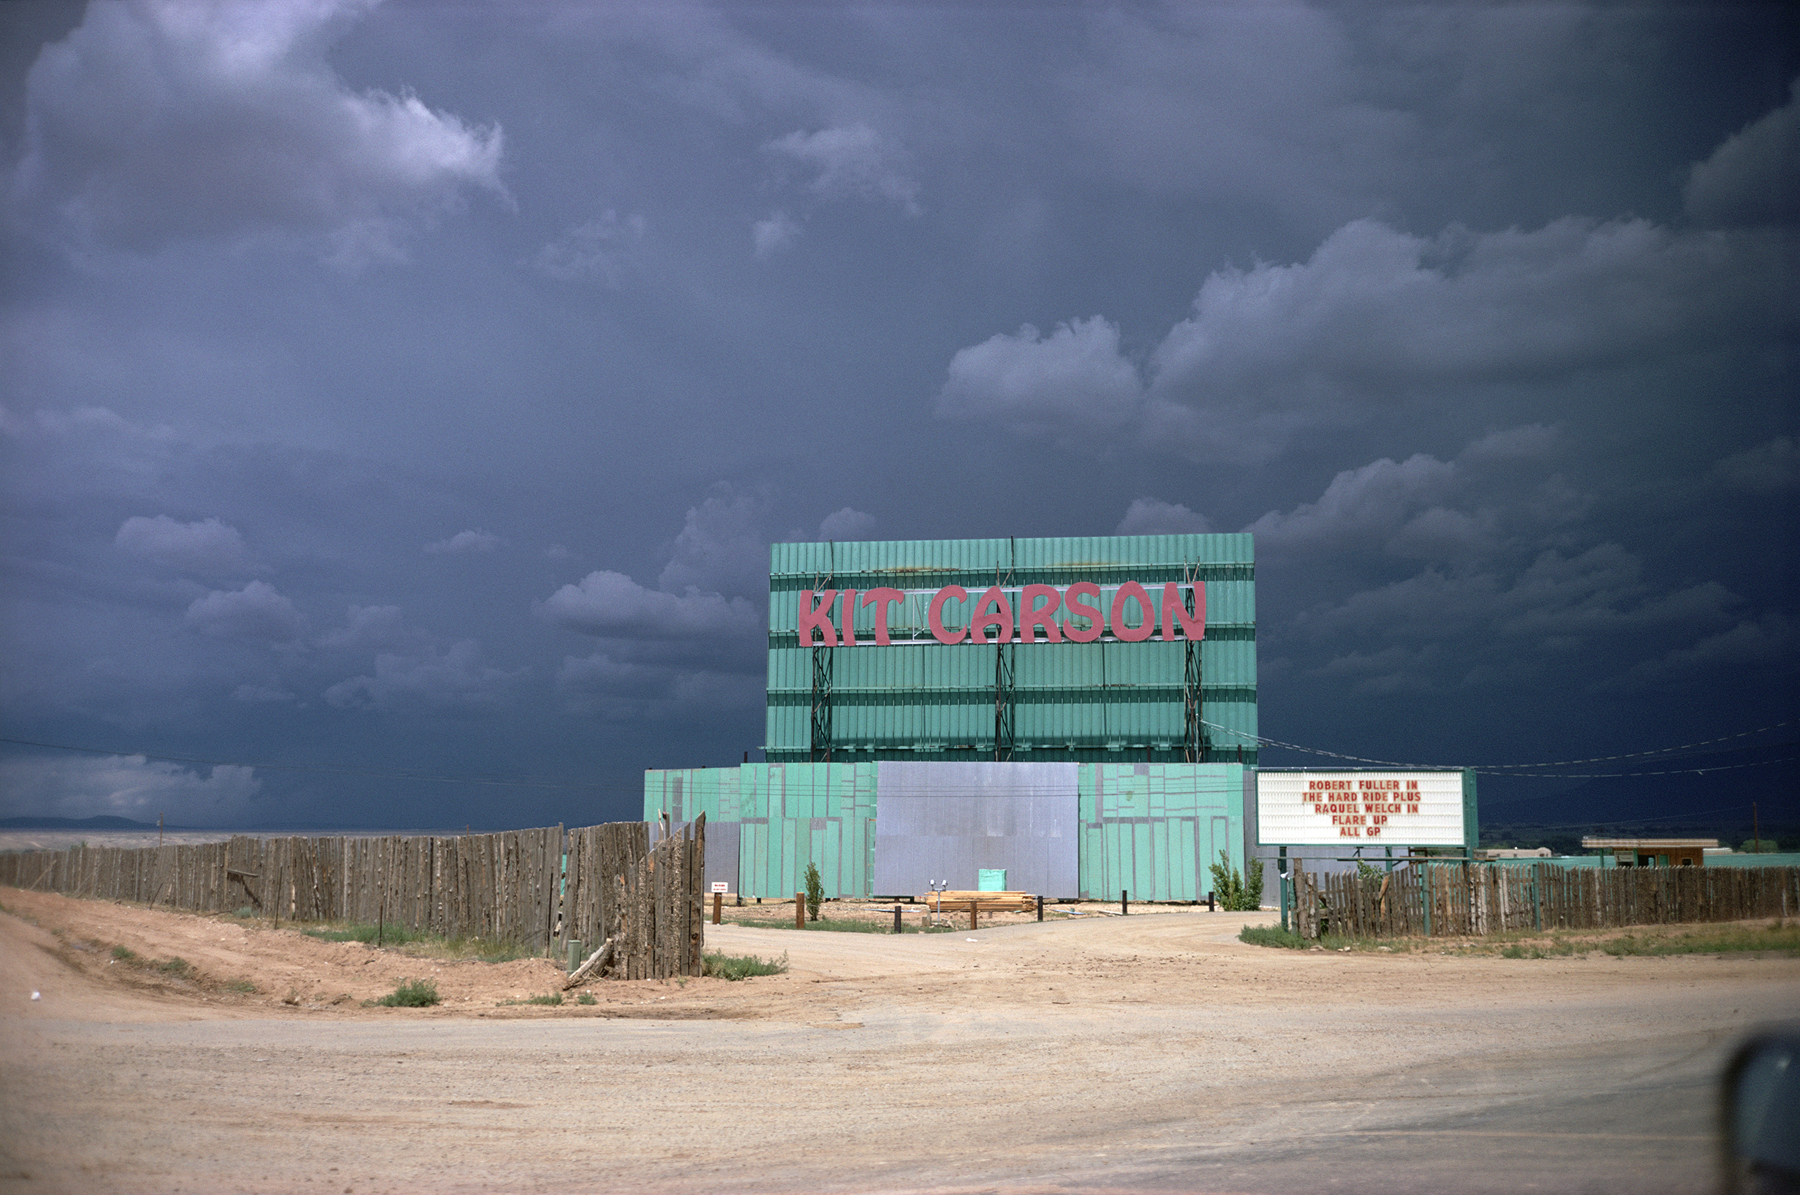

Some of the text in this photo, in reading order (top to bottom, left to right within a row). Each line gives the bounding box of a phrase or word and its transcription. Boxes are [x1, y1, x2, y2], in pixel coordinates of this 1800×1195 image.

[799, 580, 1206, 647] KIT CARSON
[1309, 780, 1418, 790] ROBERT FULLER IN
[1303, 792, 1421, 801] THE HARD RIDE PLUS
[1315, 804, 1418, 813] RAQUEL WELCH IN
[1332, 815, 1388, 825] FLARE UP
[1340, 827, 1381, 836] ALL GP
